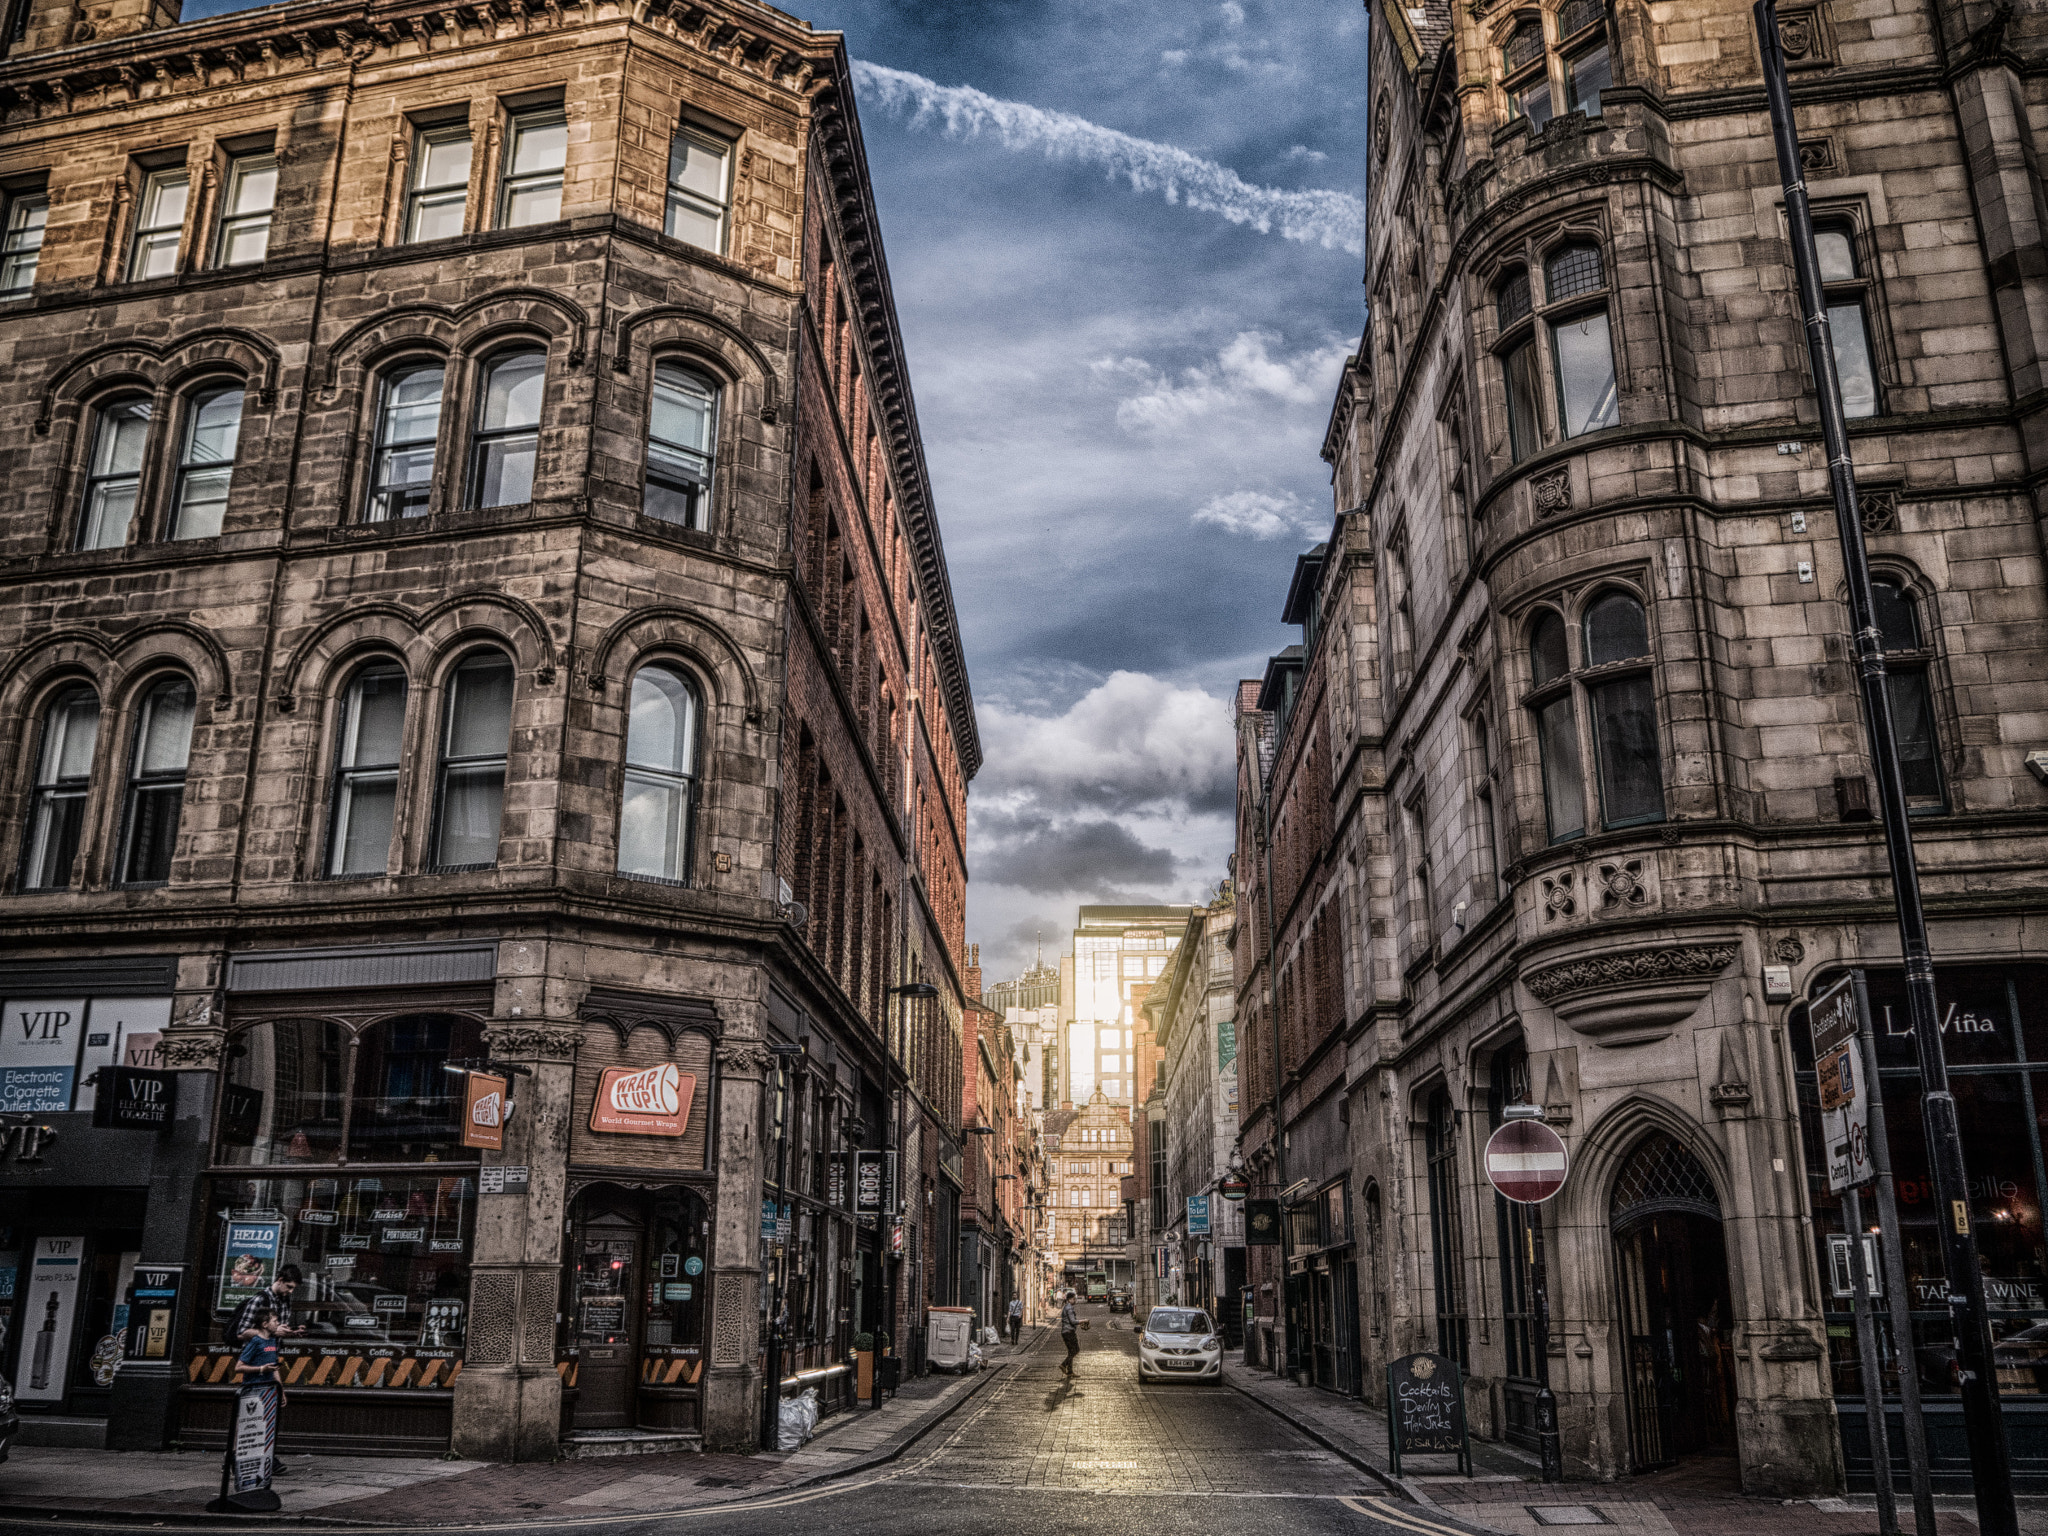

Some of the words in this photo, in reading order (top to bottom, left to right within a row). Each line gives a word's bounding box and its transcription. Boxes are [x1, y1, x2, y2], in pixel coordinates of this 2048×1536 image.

[20, 1011, 71, 1040] VIP
[130, 1049, 162, 1067] VIP
[5, 1070, 64, 1084] Electronic
[617, 1070, 658, 1093] WRAP
[4, 1085, 60, 1099] Cigarette
[128, 1077, 163, 1102] VIP
[475, 1095, 492, 1111] WRAP
[617, 1093, 630, 1108] IT
[631, 1084, 661, 1110] UP!
[34, 1099, 66, 1112] Store
[119, 1100, 169, 1113] ELECTRONIC
[120, 1109, 166, 1122] CIGARETTE
[601, 1116, 622, 1125] World
[624, 1117, 654, 1126] Gourmet
[656, 1119, 678, 1129] Wraps
[374, 1211, 403, 1220] Turkish
[233, 1229, 274, 1242] HELLO
[49, 1240, 71, 1254] VIP
[146, 1273, 169, 1286] VIP
[1992, 1283, 2040, 1298] WINE
[377, 1299, 403, 1308] GREEK
[151, 1327, 166, 1337] VIP
[320, 1348, 349, 1356] Snacks
[369, 1348, 394, 1357] Coffee
[415, 1349, 454, 1358] Breakfast
[1403, 1415, 1422, 1432] High
[1405, 1437, 1413, 1450] 2
